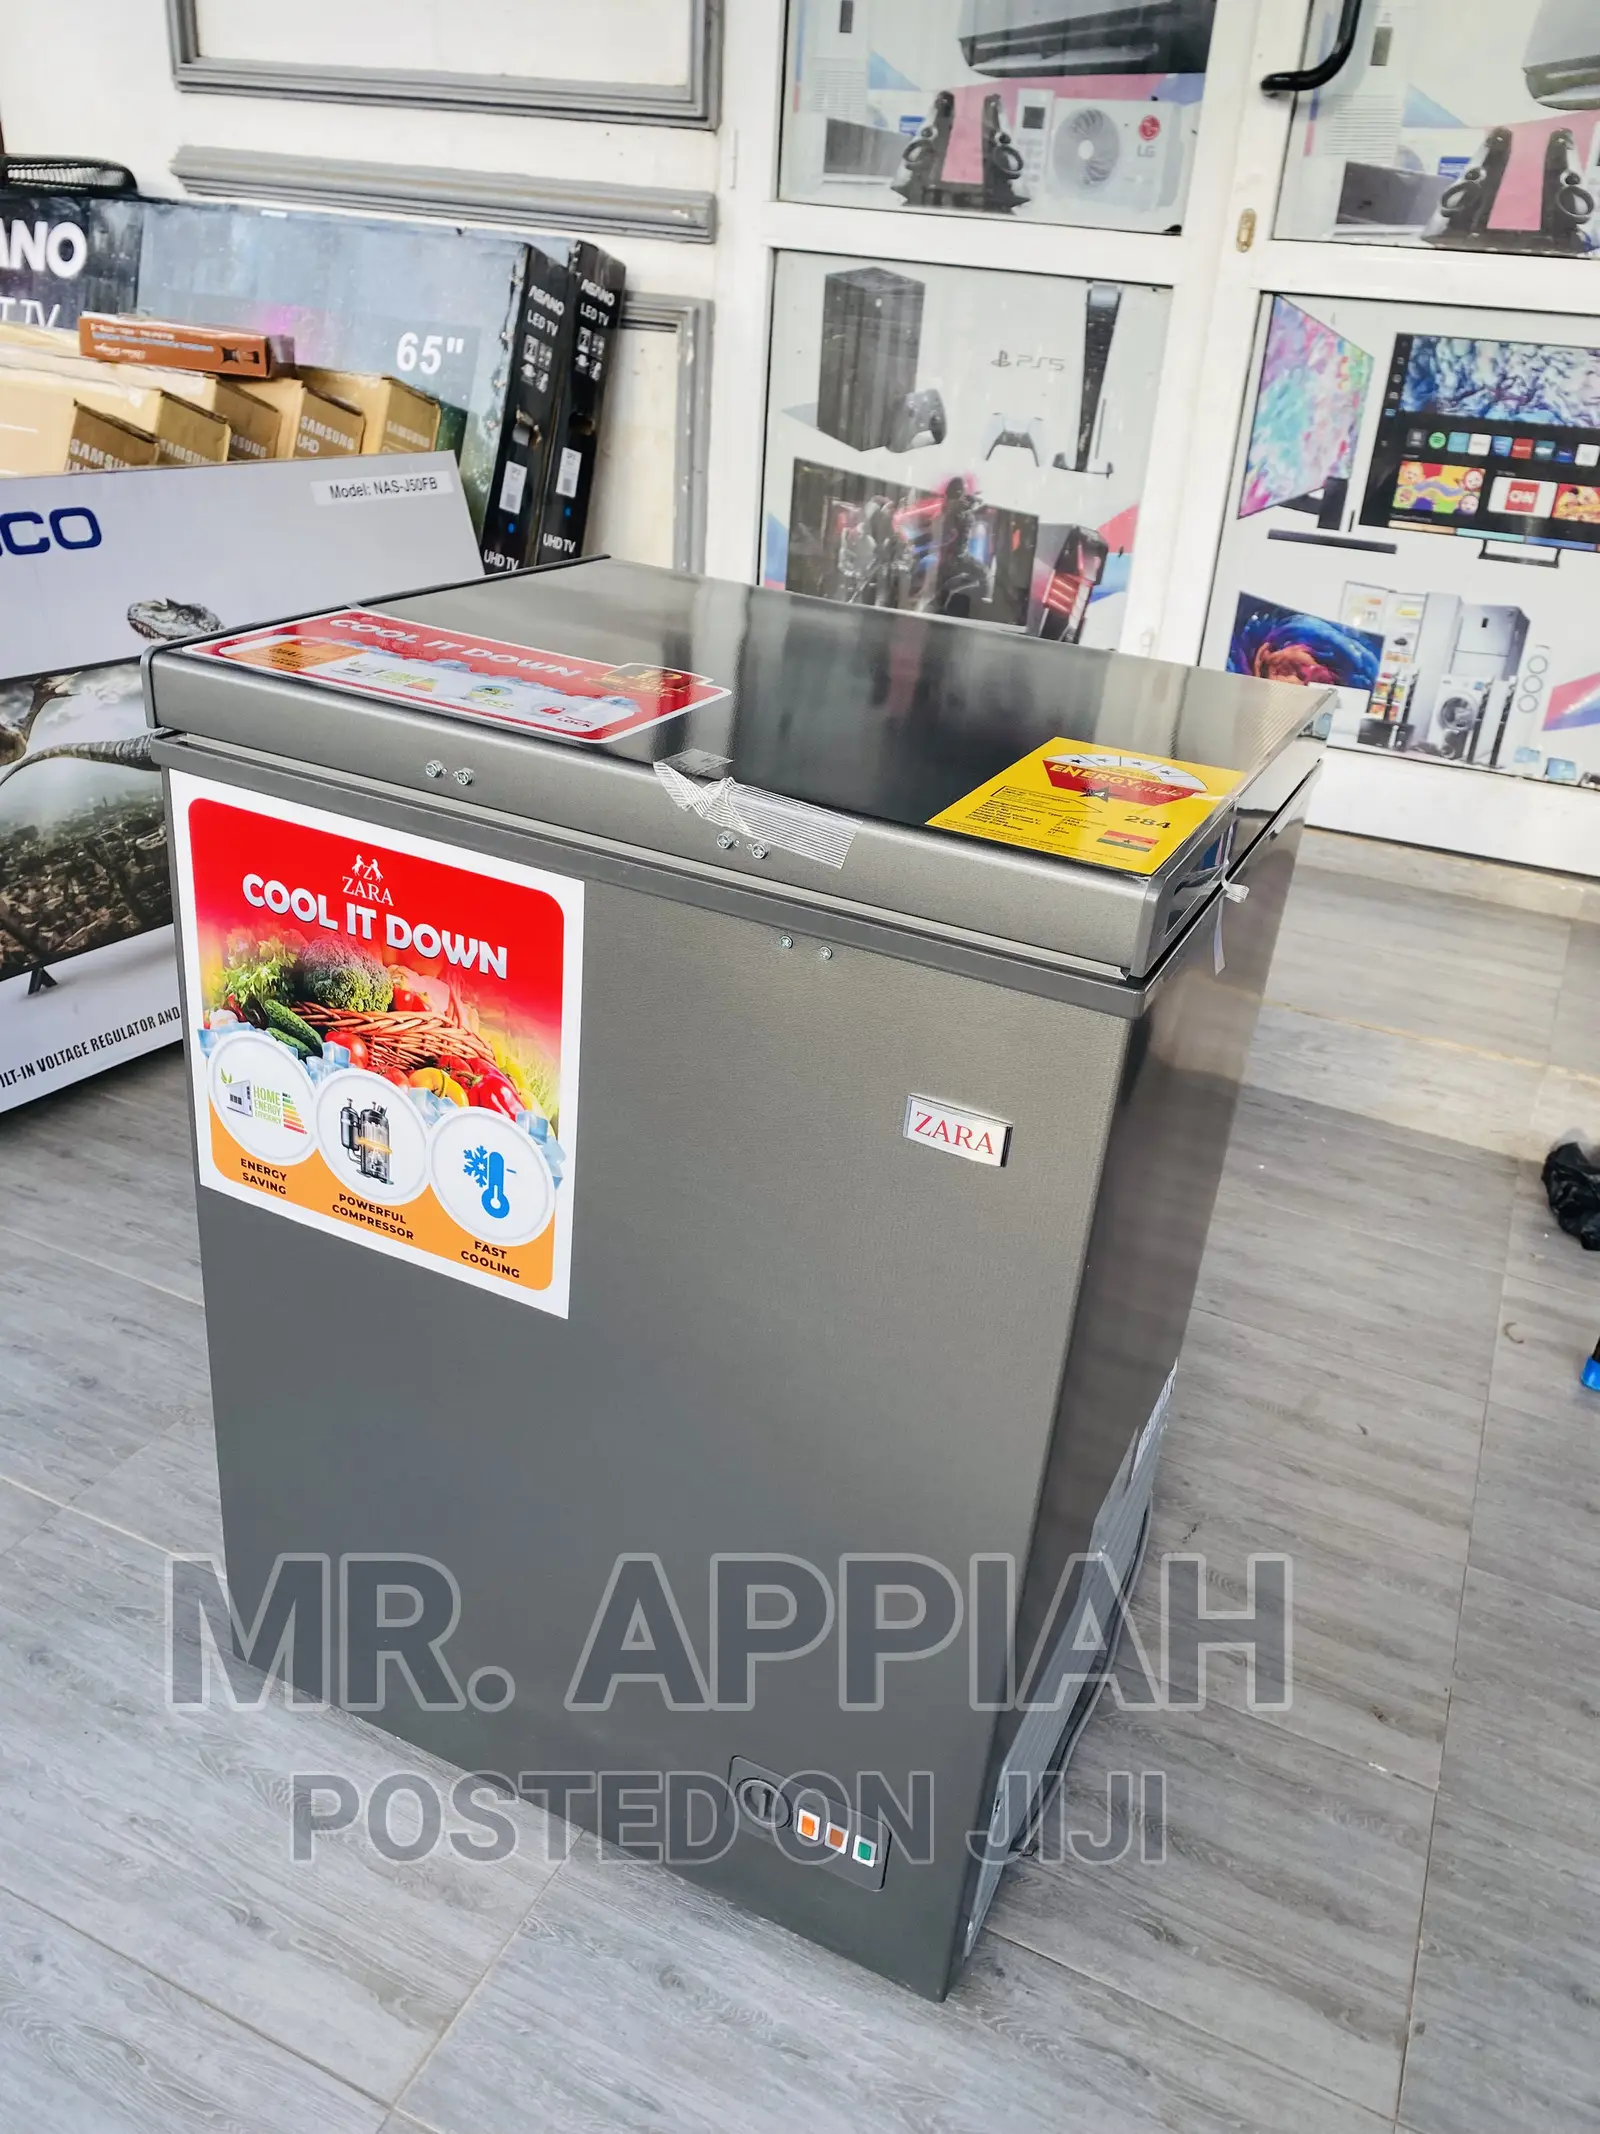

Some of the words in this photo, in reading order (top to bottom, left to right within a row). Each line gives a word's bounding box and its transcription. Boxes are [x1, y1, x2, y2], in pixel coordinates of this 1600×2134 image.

[1137, 144, 1156, 158] LG
[20, 299, 61, 328] TV
[527, 310, 545, 330] LED
[545, 320, 559, 337] TV
[580, 302, 598, 321] LED
[598, 311, 610, 326] TV
[396, 332, 465, 375] 65"
[297, 434, 320, 454] UHD
[300, 415, 355, 451] SAMSUNG
[386, 420, 431, 449] SAMSUNG
[330, 484, 371, 499] Model:
[374, 476, 438, 495] NAS-J50FB
[543, 533, 563, 550] UHD
[563, 539, 576, 553] TV
[484, 549, 505, 567] UHD
[506, 557, 519, 572] TV
[329, 619, 419, 643] COOL
[422, 640, 465, 651] IT
[460, 648, 584, 677] DOWN
[1050, 763, 1140, 787] ENERGY
[1124, 814, 1171, 829] 284
[342, 876, 394, 907] ZARA
[242, 873, 339, 931] COOL
[345, 901, 377, 940] IT
[385, 913, 508, 980] DOWN
[36, 1042, 90, 1073] VOLTAGE
[90, 1016, 157, 1052] REGULATOR
[157, 1006, 181, 1026] AND
[253, 1084, 281, 1106] HOME
[254, 1099, 281, 1117] ENERGY
[914, 1111, 995, 1156] ZARA
[240, 1158, 288, 1182] ENERGY
[242, 1171, 287, 1195] SAVING
[339, 1193, 407, 1225] POWERFUL
[332, 1204, 414, 1241] COMPRESSOR
[474, 1240, 507, 1260] FAST
[461, 1250, 521, 1279] COOLING
